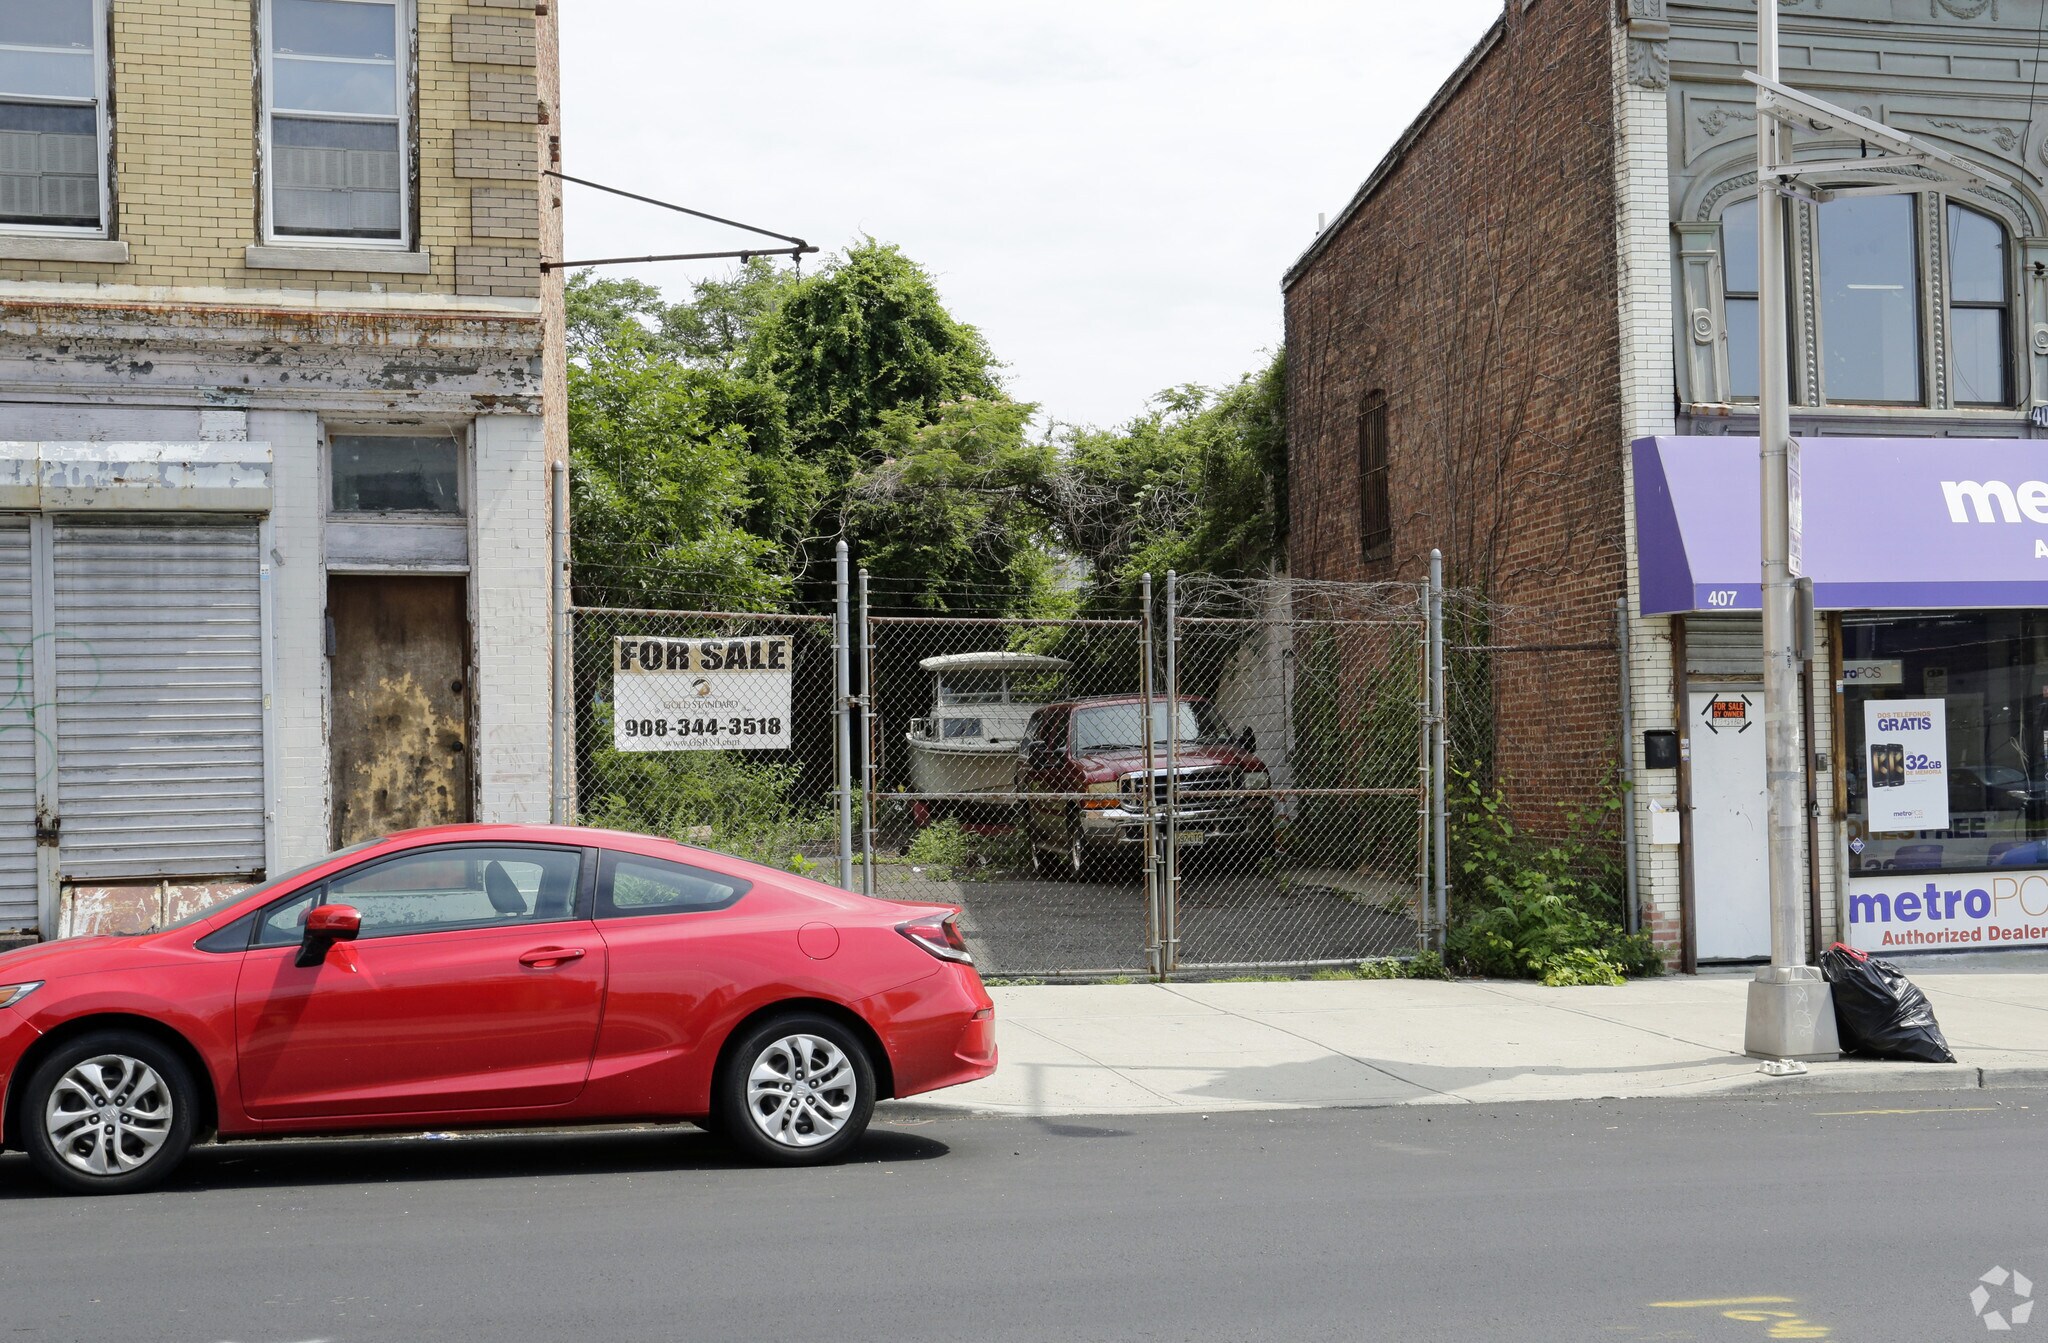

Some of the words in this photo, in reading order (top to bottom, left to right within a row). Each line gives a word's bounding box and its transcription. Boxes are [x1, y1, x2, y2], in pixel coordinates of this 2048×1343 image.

[1940, 480, 2048, 524] me
[1708, 590, 1737, 606] 407
[621, 641, 690, 670] FOR
[701, 641, 786, 670] SALE
[1843, 666, 1881, 679] roPCS
[664, 701, 690, 709] GOLD
[692, 700, 738, 709] STANDARD
[1713, 702, 1726, 710] FOR
[1728, 702, 1744, 710] SALE
[625, 717, 781, 737] 908-344-3518
[1877, 717, 1932, 732] GRATIS
[1850, 875, 2048, 924] metroPC
[1882, 926, 1982, 946] Authorized
[1988, 924, 2048, 941] Dealer
